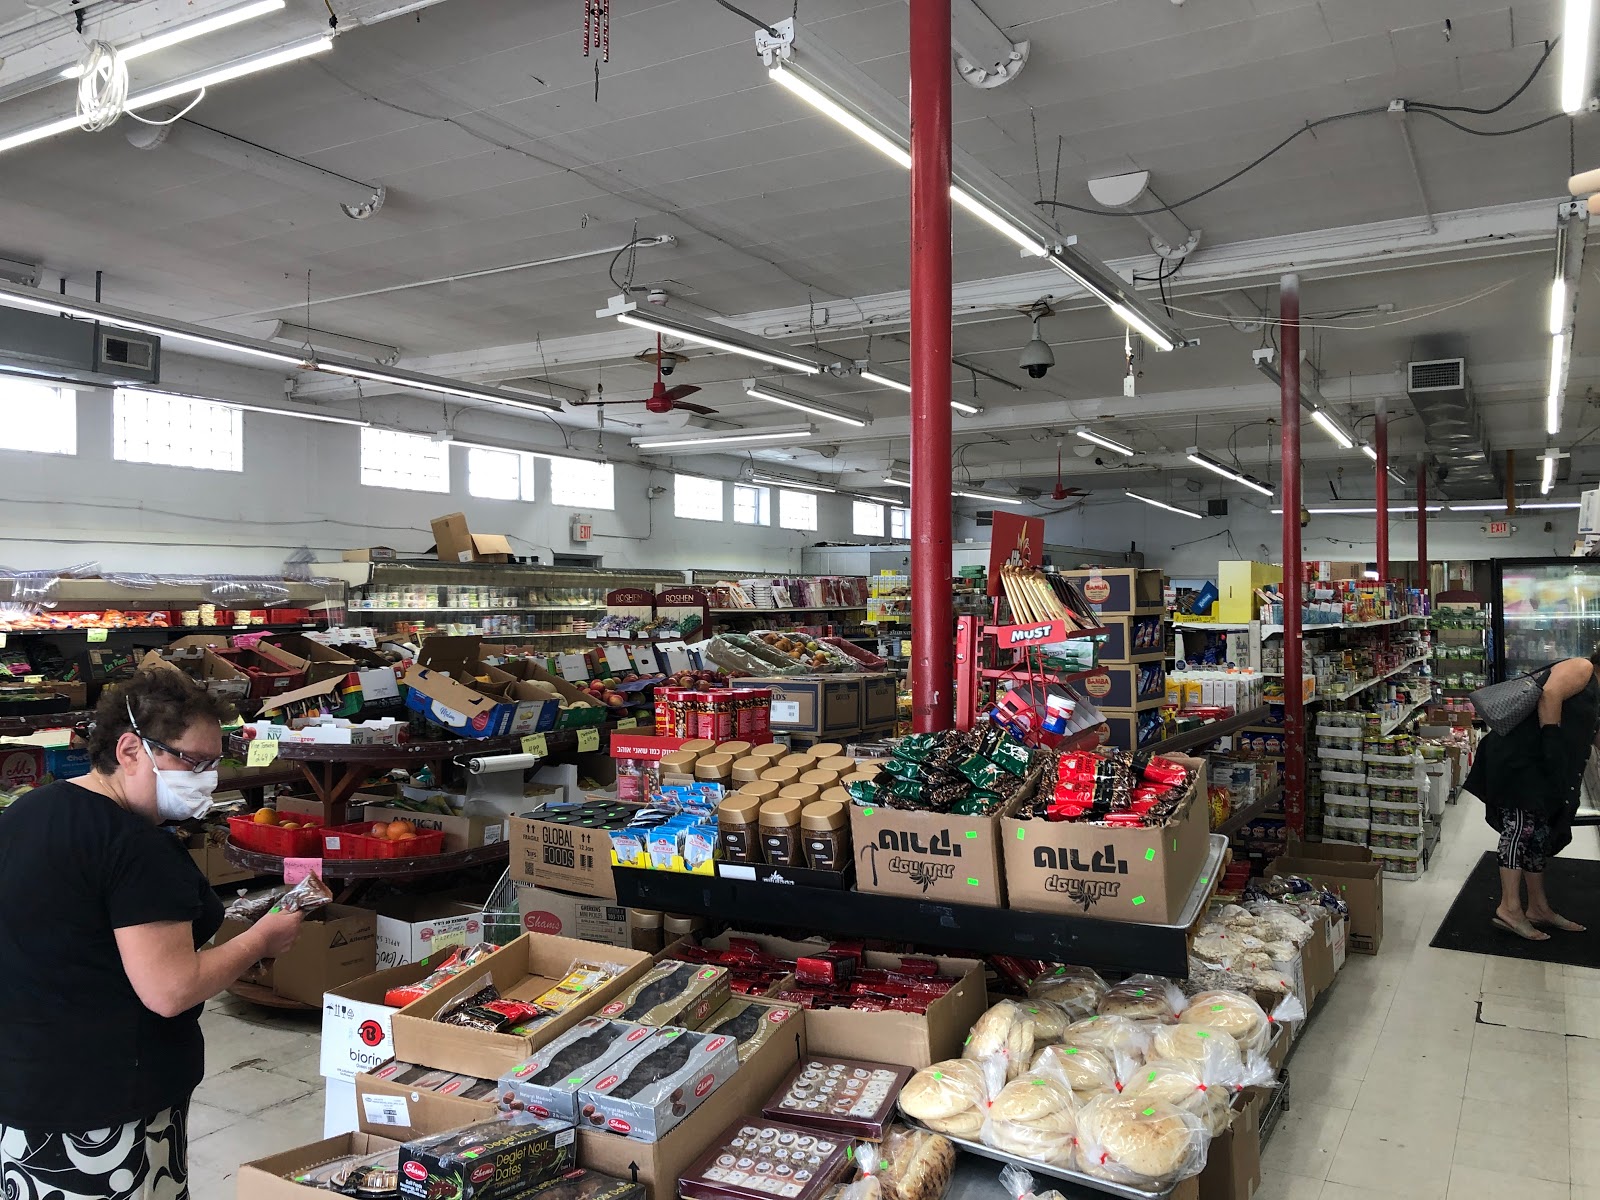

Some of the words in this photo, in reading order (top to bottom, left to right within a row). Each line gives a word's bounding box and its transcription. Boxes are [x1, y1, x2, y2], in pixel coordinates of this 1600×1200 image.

[579, 525, 592, 540] EXIT
[1490, 522, 1508, 534] EXIT
[615, 593, 643, 603] ROSHEN
[665, 594, 694, 604] ROSHEN
[1010, 624, 1053, 643] MUST
[1086, 677, 1110, 686] BAMBA
[771, 692, 787, 701] LD'S
[522, 833, 540, 842] FRAGILE
[542, 826, 575, 848] GLOBAL
[878, 829, 962, 858] טורקי
[542, 845, 575, 868] FOODS
[1033, 844, 1129, 875] טורקי
[888, 856, 919, 876] קפה
[921, 861, 956, 881] עלית
[1044, 874, 1081, 894] קפה
[1083, 880, 1120, 901] עלית
[526, 915, 561, 930] Shams
[385, 937, 400, 947] APPLE
[349, 1048, 388, 1066] biorin
[696, 1077, 714, 1096] Shams
[609, 1119, 631, 1132] Shams
[496, 1146, 527, 1168] Deglet
[527, 1140, 549, 1156] Nour
[405, 1163, 426, 1178] Shams
[472, 1166, 494, 1180] Shams
[495, 1163, 522, 1182] Dates
